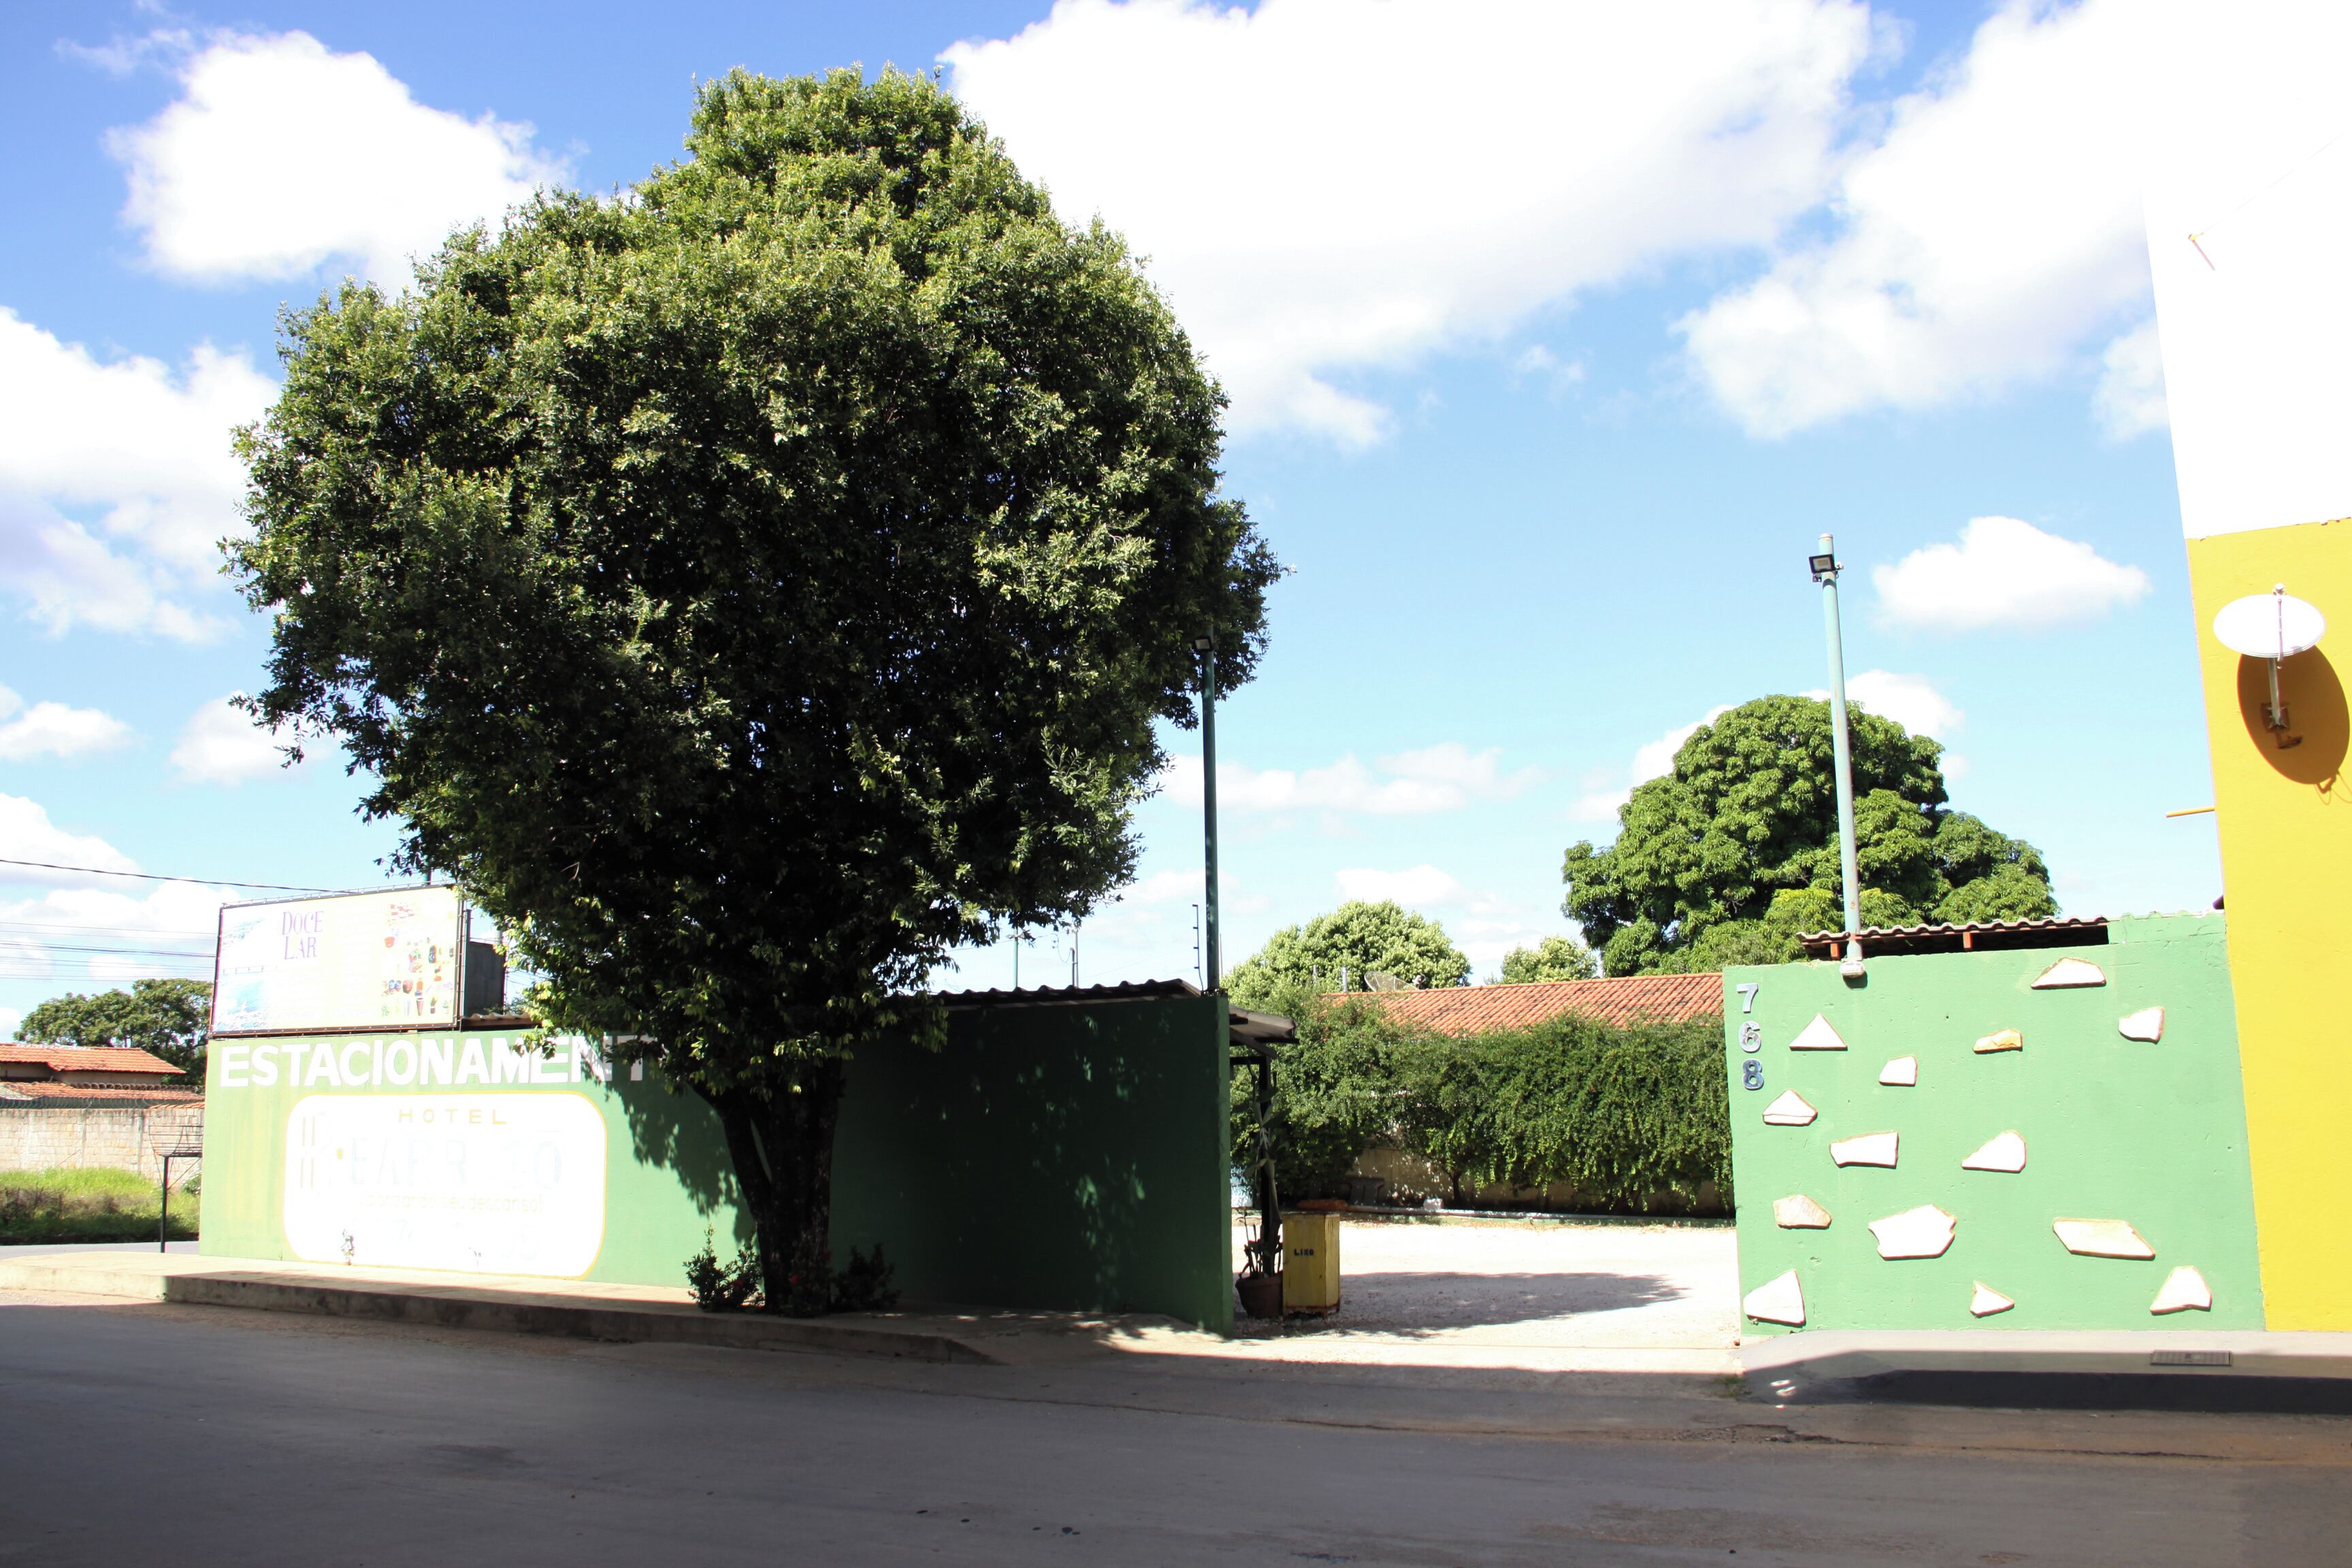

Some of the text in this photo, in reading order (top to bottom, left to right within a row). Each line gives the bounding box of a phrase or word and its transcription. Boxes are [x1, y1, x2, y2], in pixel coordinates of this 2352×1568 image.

[282, 911, 325, 935] DOCE
[284, 936, 317, 960] LAR
[1736, 983, 1764, 1090] 768
[220, 1035, 671, 1087] ESTACIONAMENT
[398, 1108, 507, 1125] HOTEL
